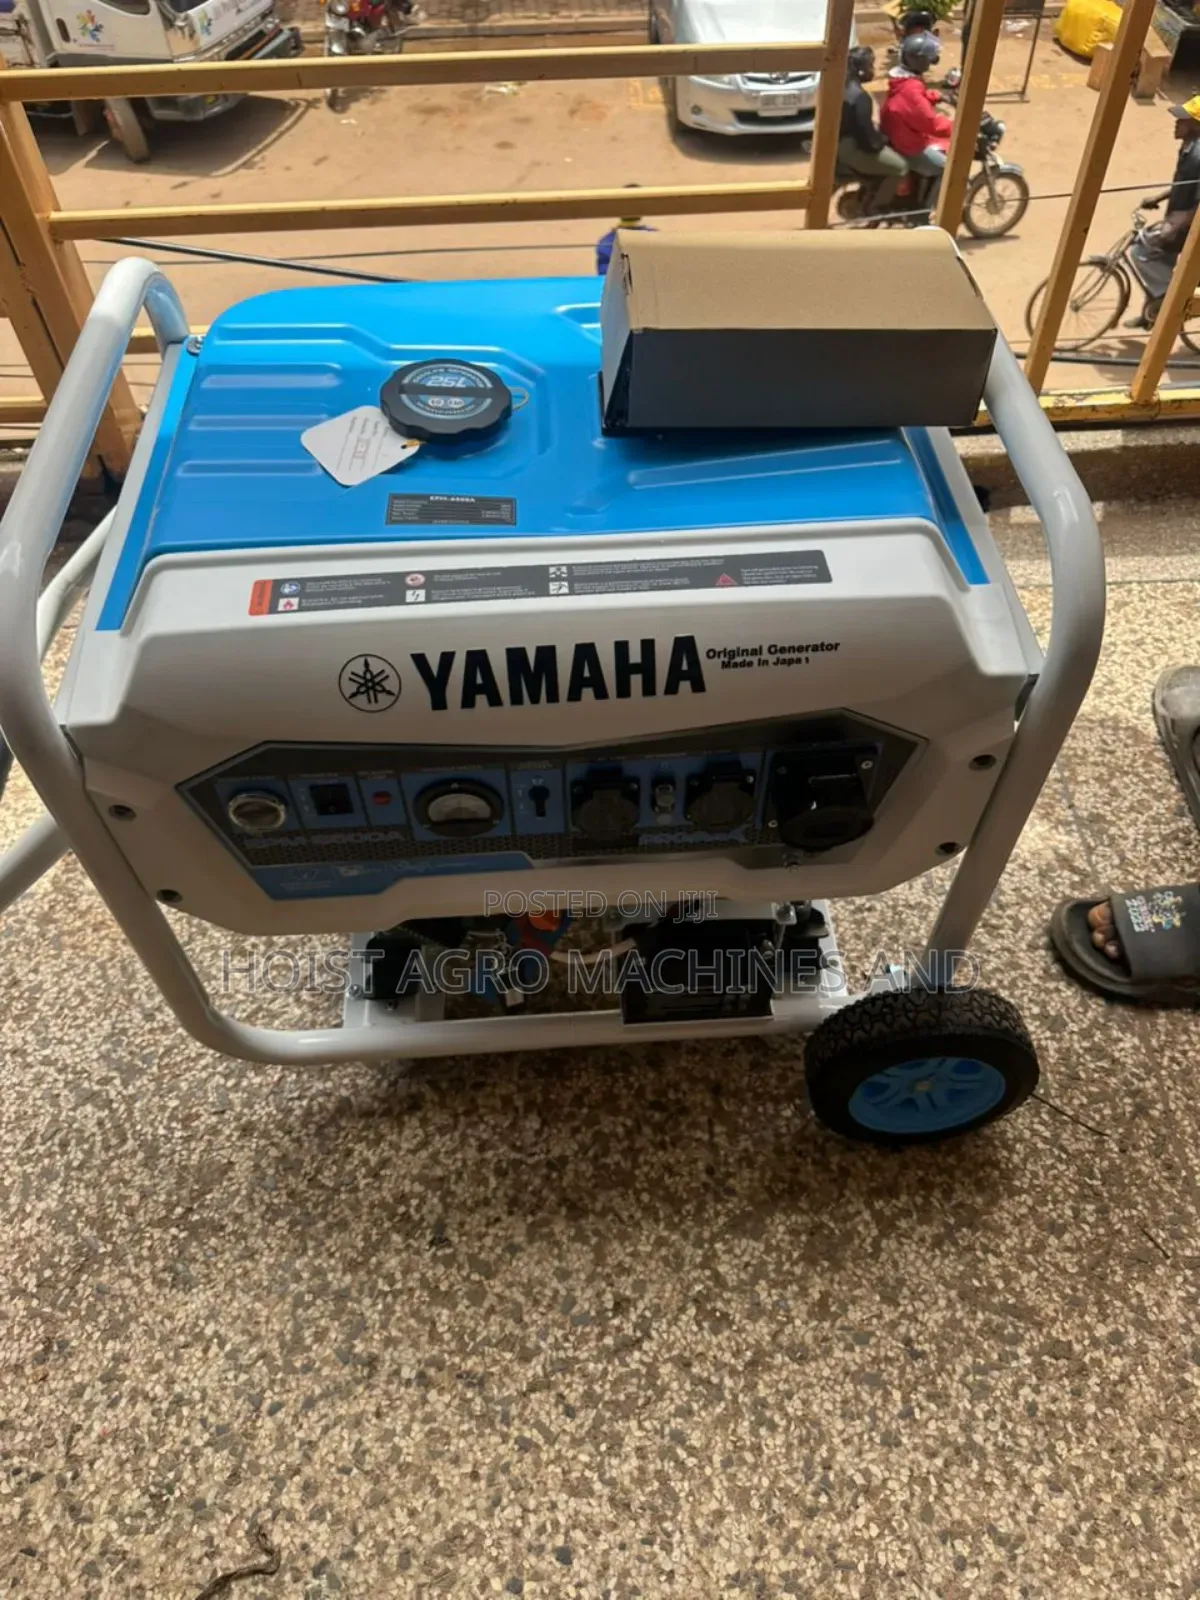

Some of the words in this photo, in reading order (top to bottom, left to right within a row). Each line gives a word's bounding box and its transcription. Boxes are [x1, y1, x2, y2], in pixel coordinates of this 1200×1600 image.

[705, 645, 763, 660] Original
[767, 641, 841, 655] Generator
[410, 635, 706, 711] YAMAHA
[721, 658, 754, 670] Made
[757, 658, 769, 667] In
